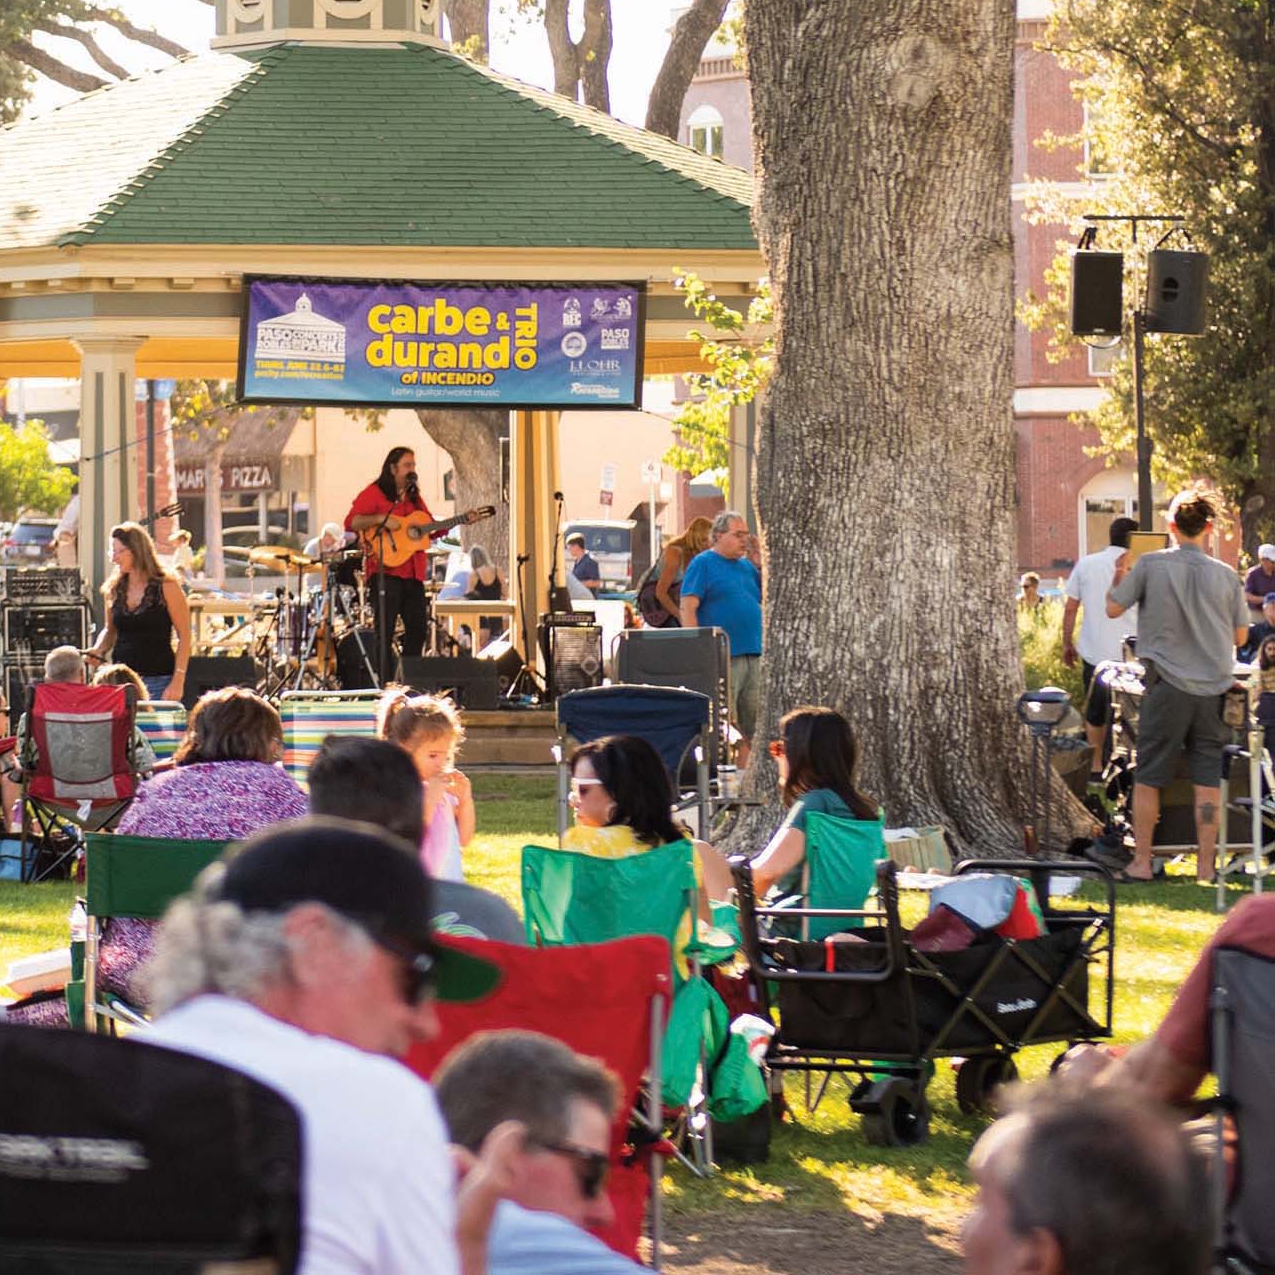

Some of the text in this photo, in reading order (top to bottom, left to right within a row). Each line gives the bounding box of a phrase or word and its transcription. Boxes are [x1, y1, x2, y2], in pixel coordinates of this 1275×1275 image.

[368, 298, 510, 336] carbe &
[514, 303, 538, 370] TRIO
[601, 328, 629, 340] PASO
[366, 334, 510, 369] durand
[401, 372, 494, 385] of INCENDIO
[232, 466, 272, 487] PIZZA
